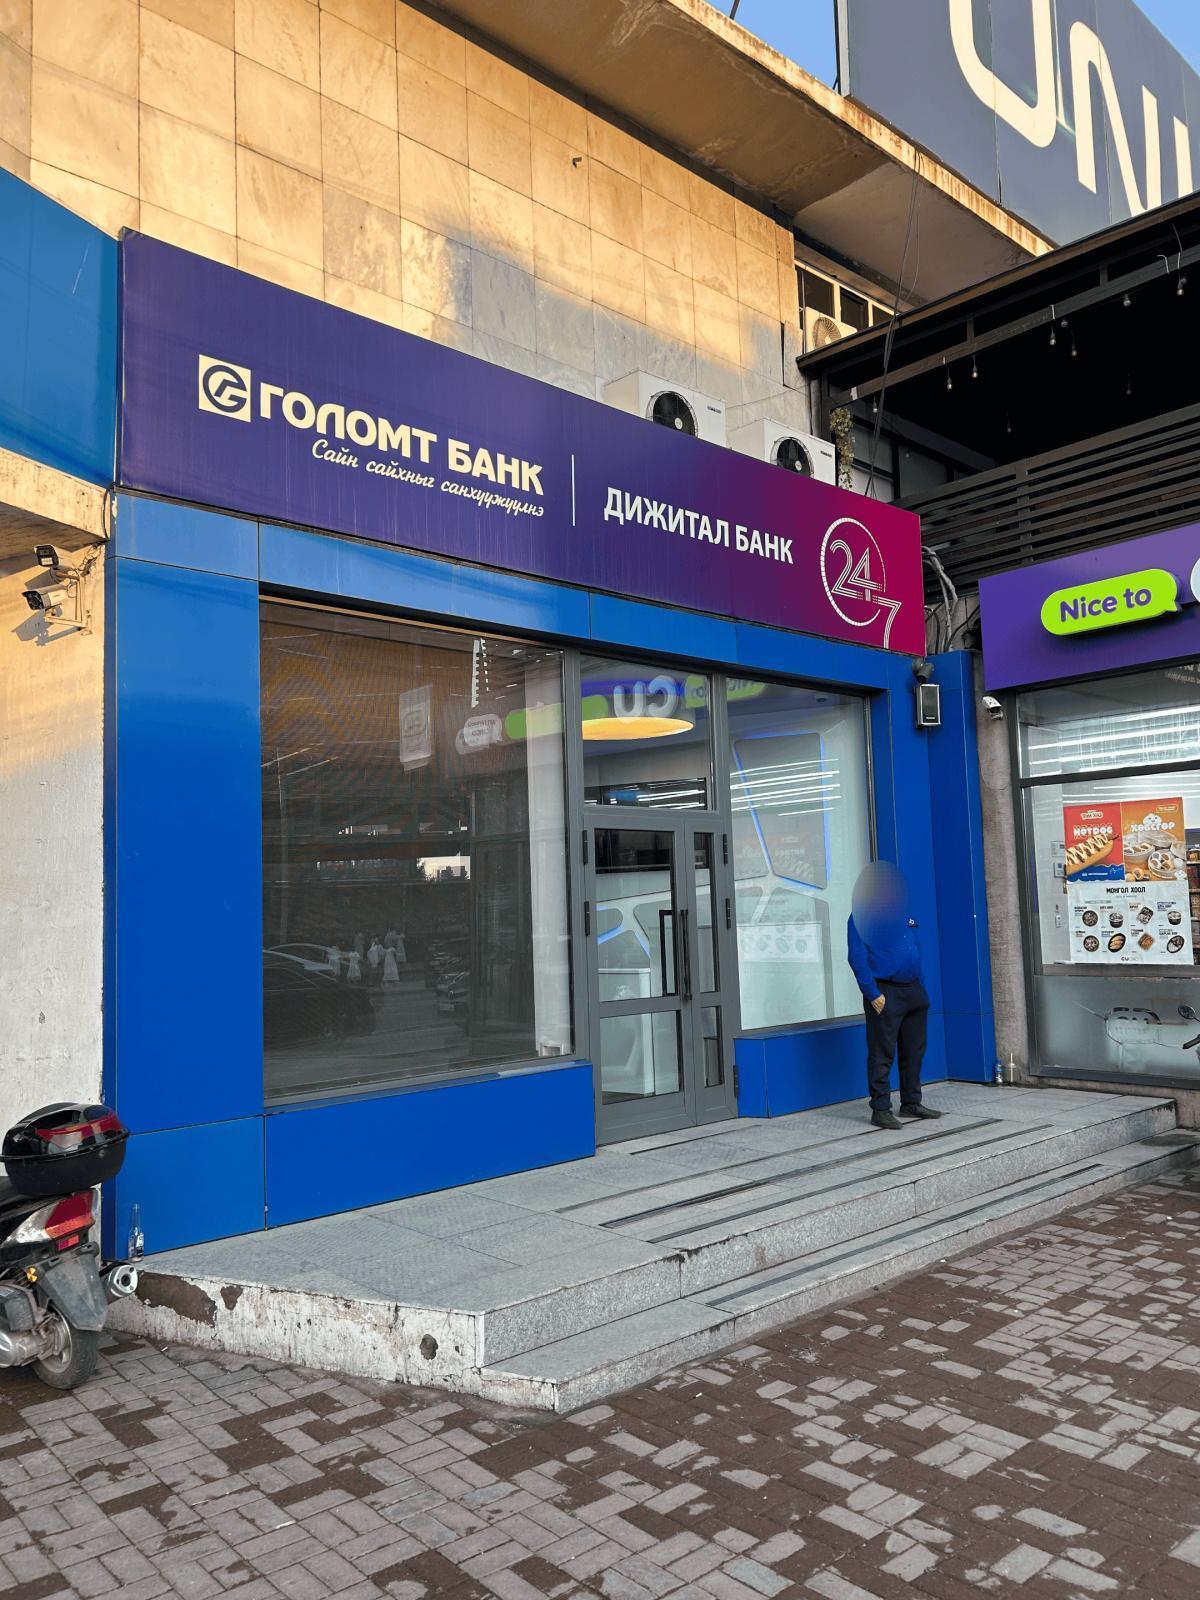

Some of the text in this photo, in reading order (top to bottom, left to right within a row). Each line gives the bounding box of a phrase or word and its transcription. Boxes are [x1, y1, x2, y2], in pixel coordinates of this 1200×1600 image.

[260, 382, 544, 496] ГОЛОМТ БАНК
[312, 439, 359, 468] Сайн
[366, 460, 435, 488] сайхныг
[604, 486, 794, 565] ДИЖИТАЛ БАНК
[1059, 588, 1152, 622] Nice to
